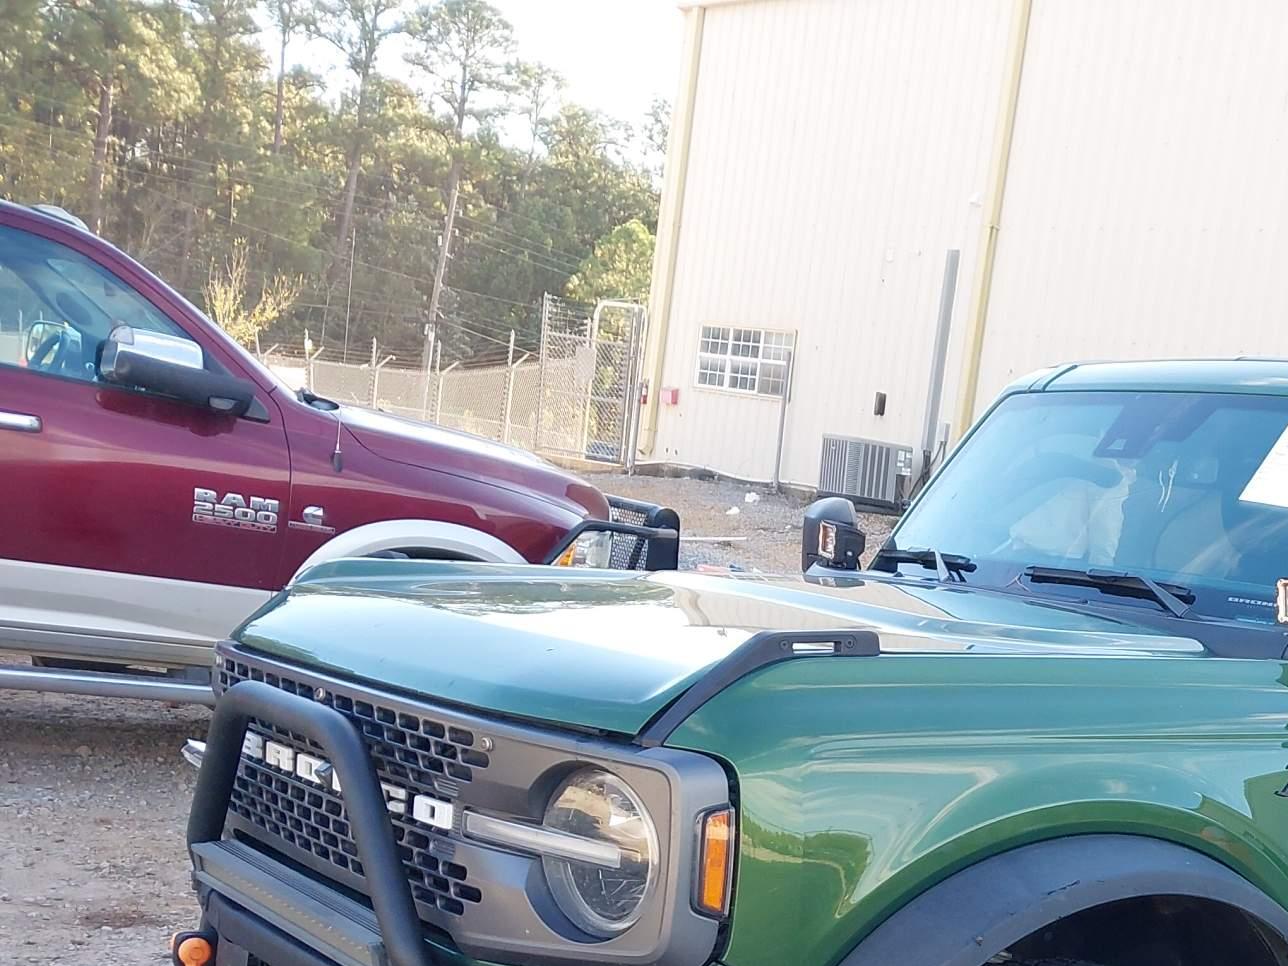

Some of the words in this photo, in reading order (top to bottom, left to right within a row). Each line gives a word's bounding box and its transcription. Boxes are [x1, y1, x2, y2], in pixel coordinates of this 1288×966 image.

[193, 501, 278, 525] 2500
[194, 487, 280, 513] RAM
[242, 730, 453, 830] BROCO
